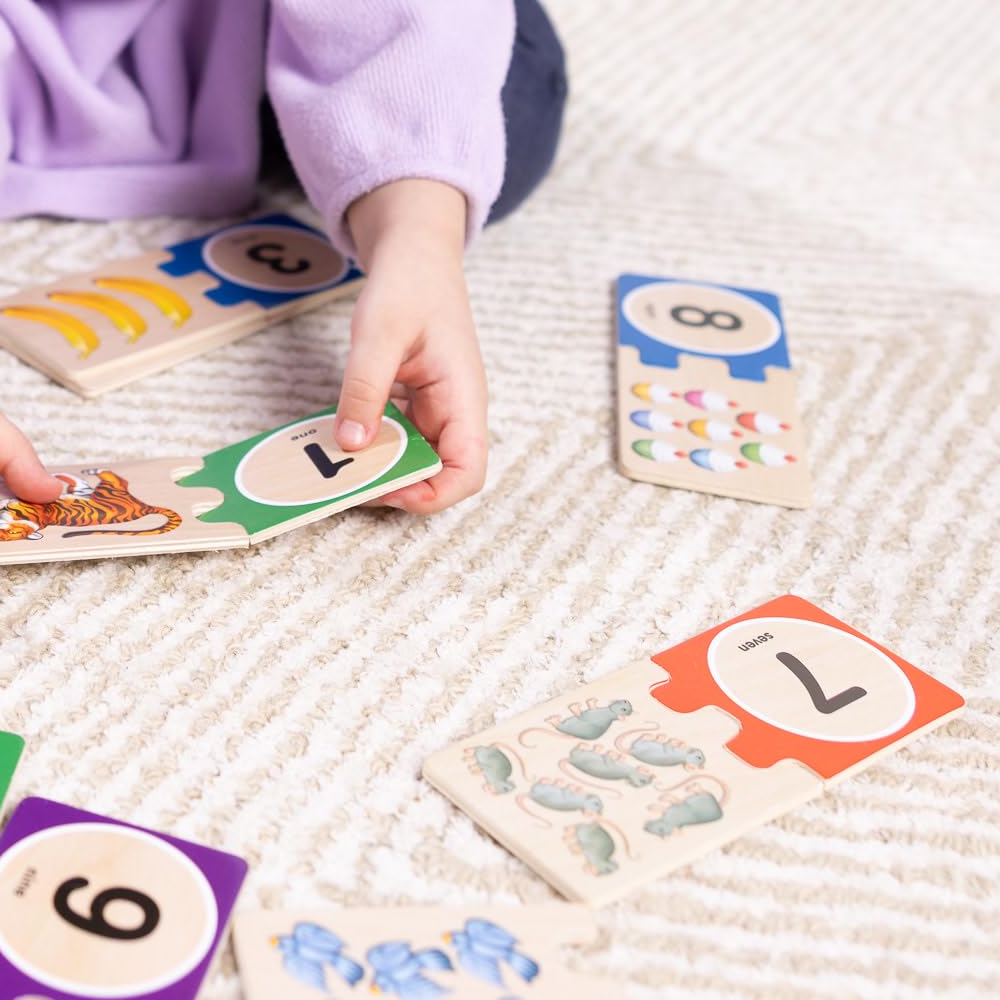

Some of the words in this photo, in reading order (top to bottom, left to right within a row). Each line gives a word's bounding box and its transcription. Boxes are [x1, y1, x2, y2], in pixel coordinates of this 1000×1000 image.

[247, 243, 311, 274] 3
[670, 306, 743, 331] 8
[290, 429, 317, 441] one
[304, 443, 354, 479] 1
[738, 632, 774, 652] seven
[776, 652, 867, 714] 7
[53, 876, 160, 941] 9
